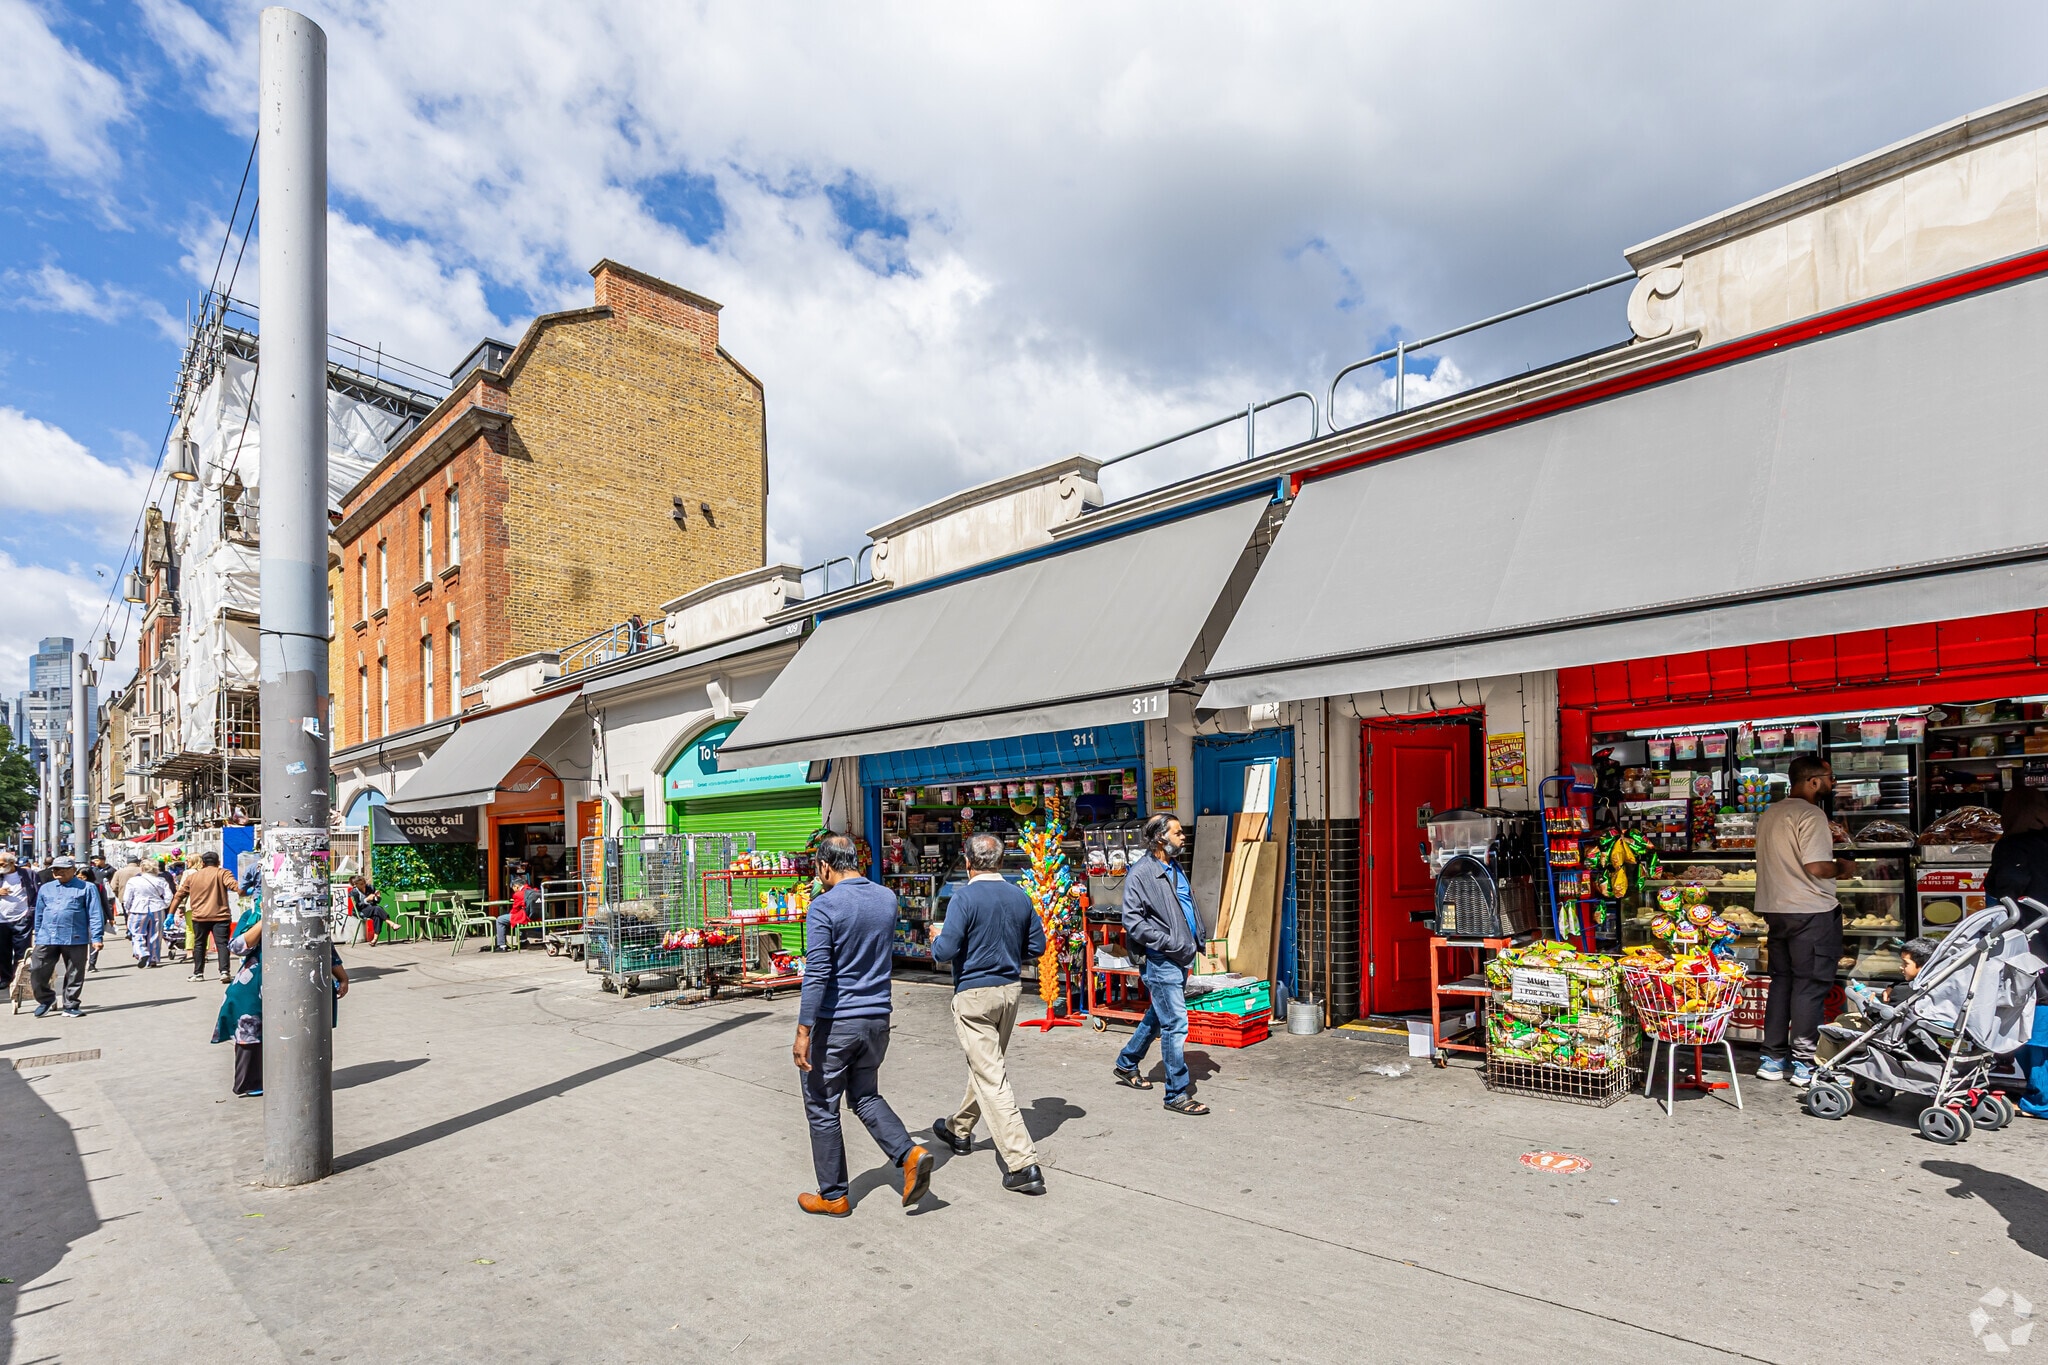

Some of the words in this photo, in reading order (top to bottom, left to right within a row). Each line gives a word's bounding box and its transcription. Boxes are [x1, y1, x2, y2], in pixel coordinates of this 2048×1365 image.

[1132, 695, 1158, 715] 311
[1073, 732, 1094, 747] 311
[699, 745, 711, 760] To
[390, 815, 437, 826] mouse
[441, 813, 464, 826] tail
[406, 826, 449, 839] coffee
[1527, 977, 1550, 987] MURI
[1525, 988, 1538, 996] FOR
